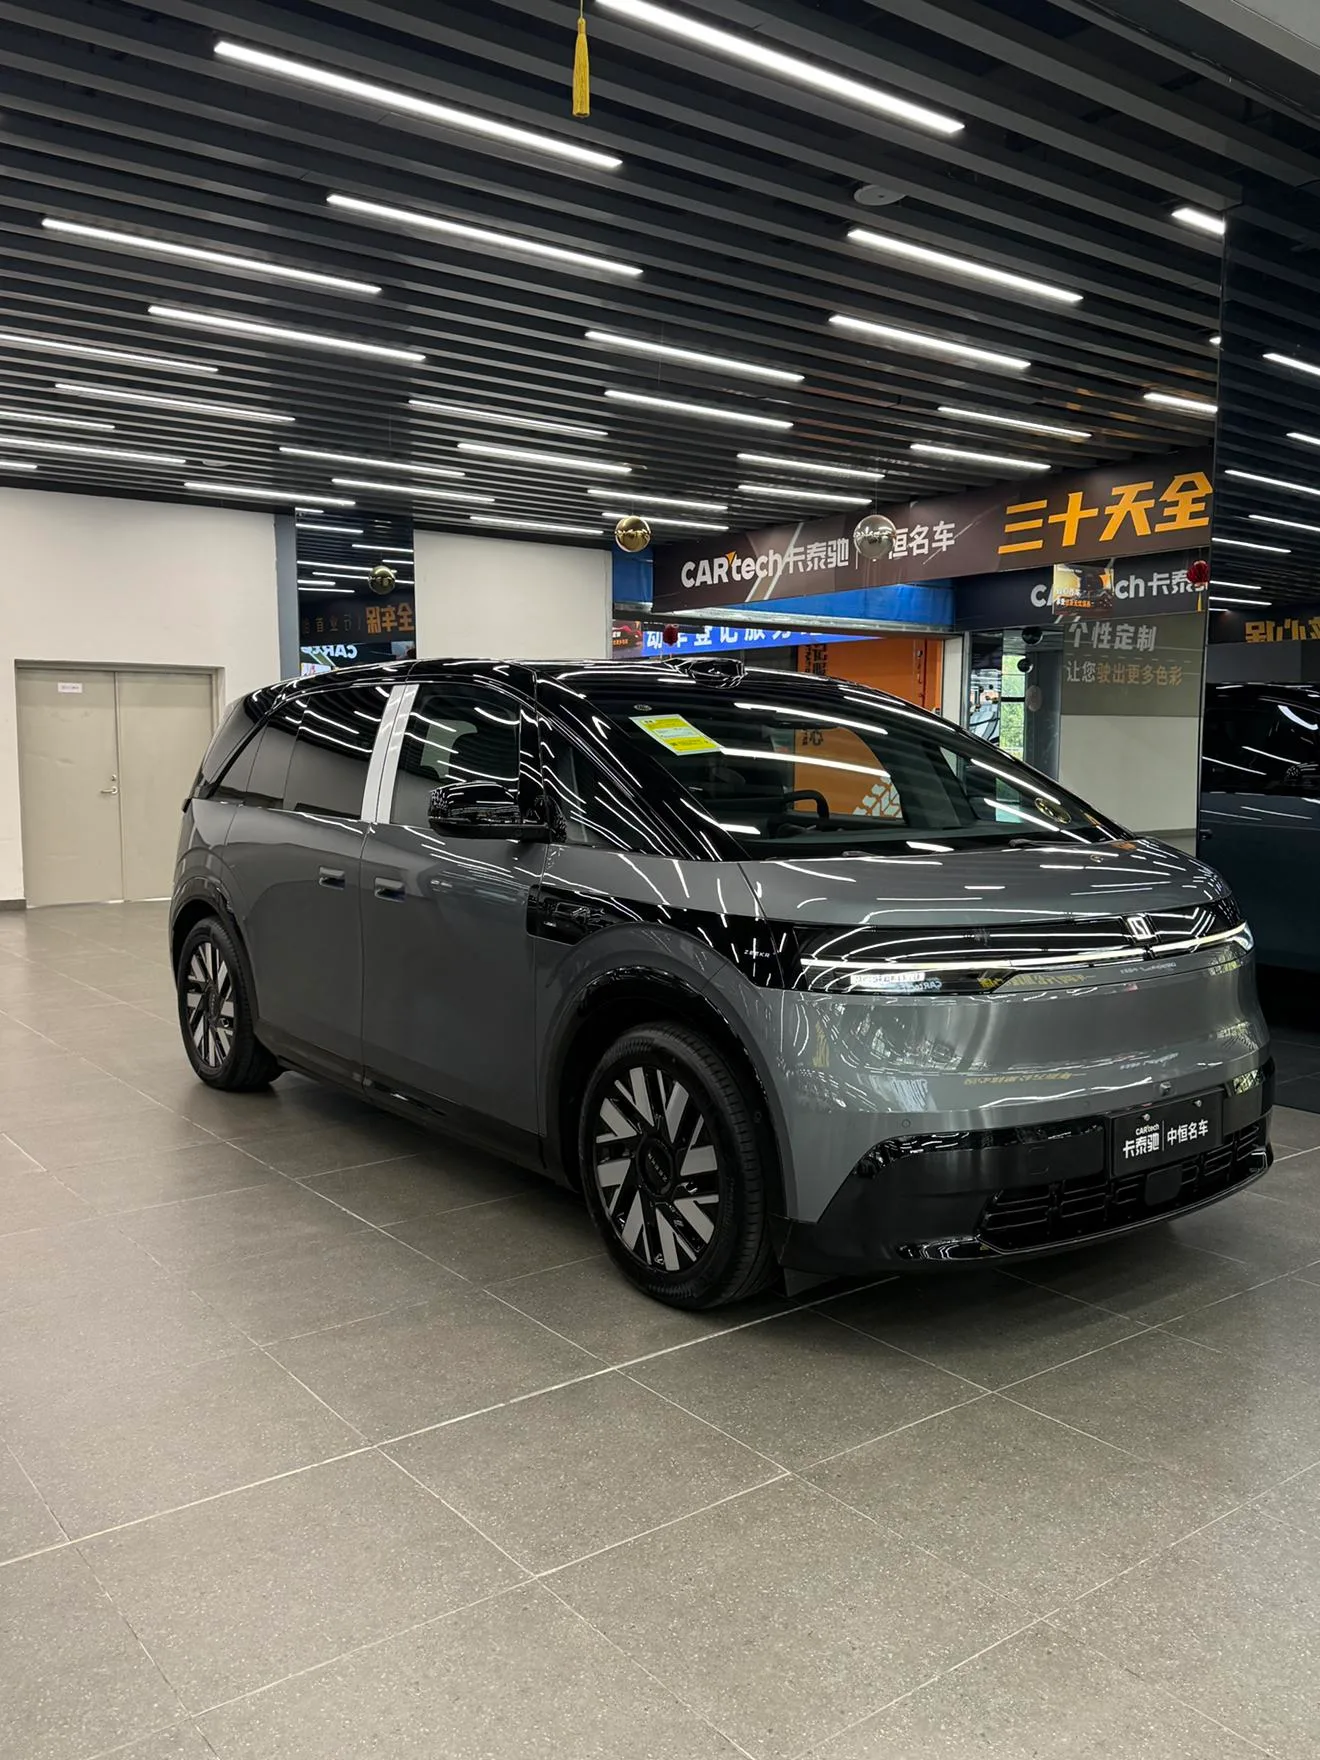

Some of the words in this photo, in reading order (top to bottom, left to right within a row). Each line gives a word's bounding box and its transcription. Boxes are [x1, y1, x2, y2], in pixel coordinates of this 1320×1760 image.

[998, 471, 1213, 554] 三十天全
[681, 550, 783, 588] CARtech
[784, 538, 849, 574] 卡泰驰
[873, 520, 955, 561] 恒名车
[1148, 569, 1208, 596] 卡泰
[1068, 615, 1157, 651] 个性定制
[1066, 660, 1183, 686] 让您驶出更多色彩
[1123, 1132, 1160, 1159] 卡泰驰
[1167, 1119, 1208, 1146] 中恒名车
